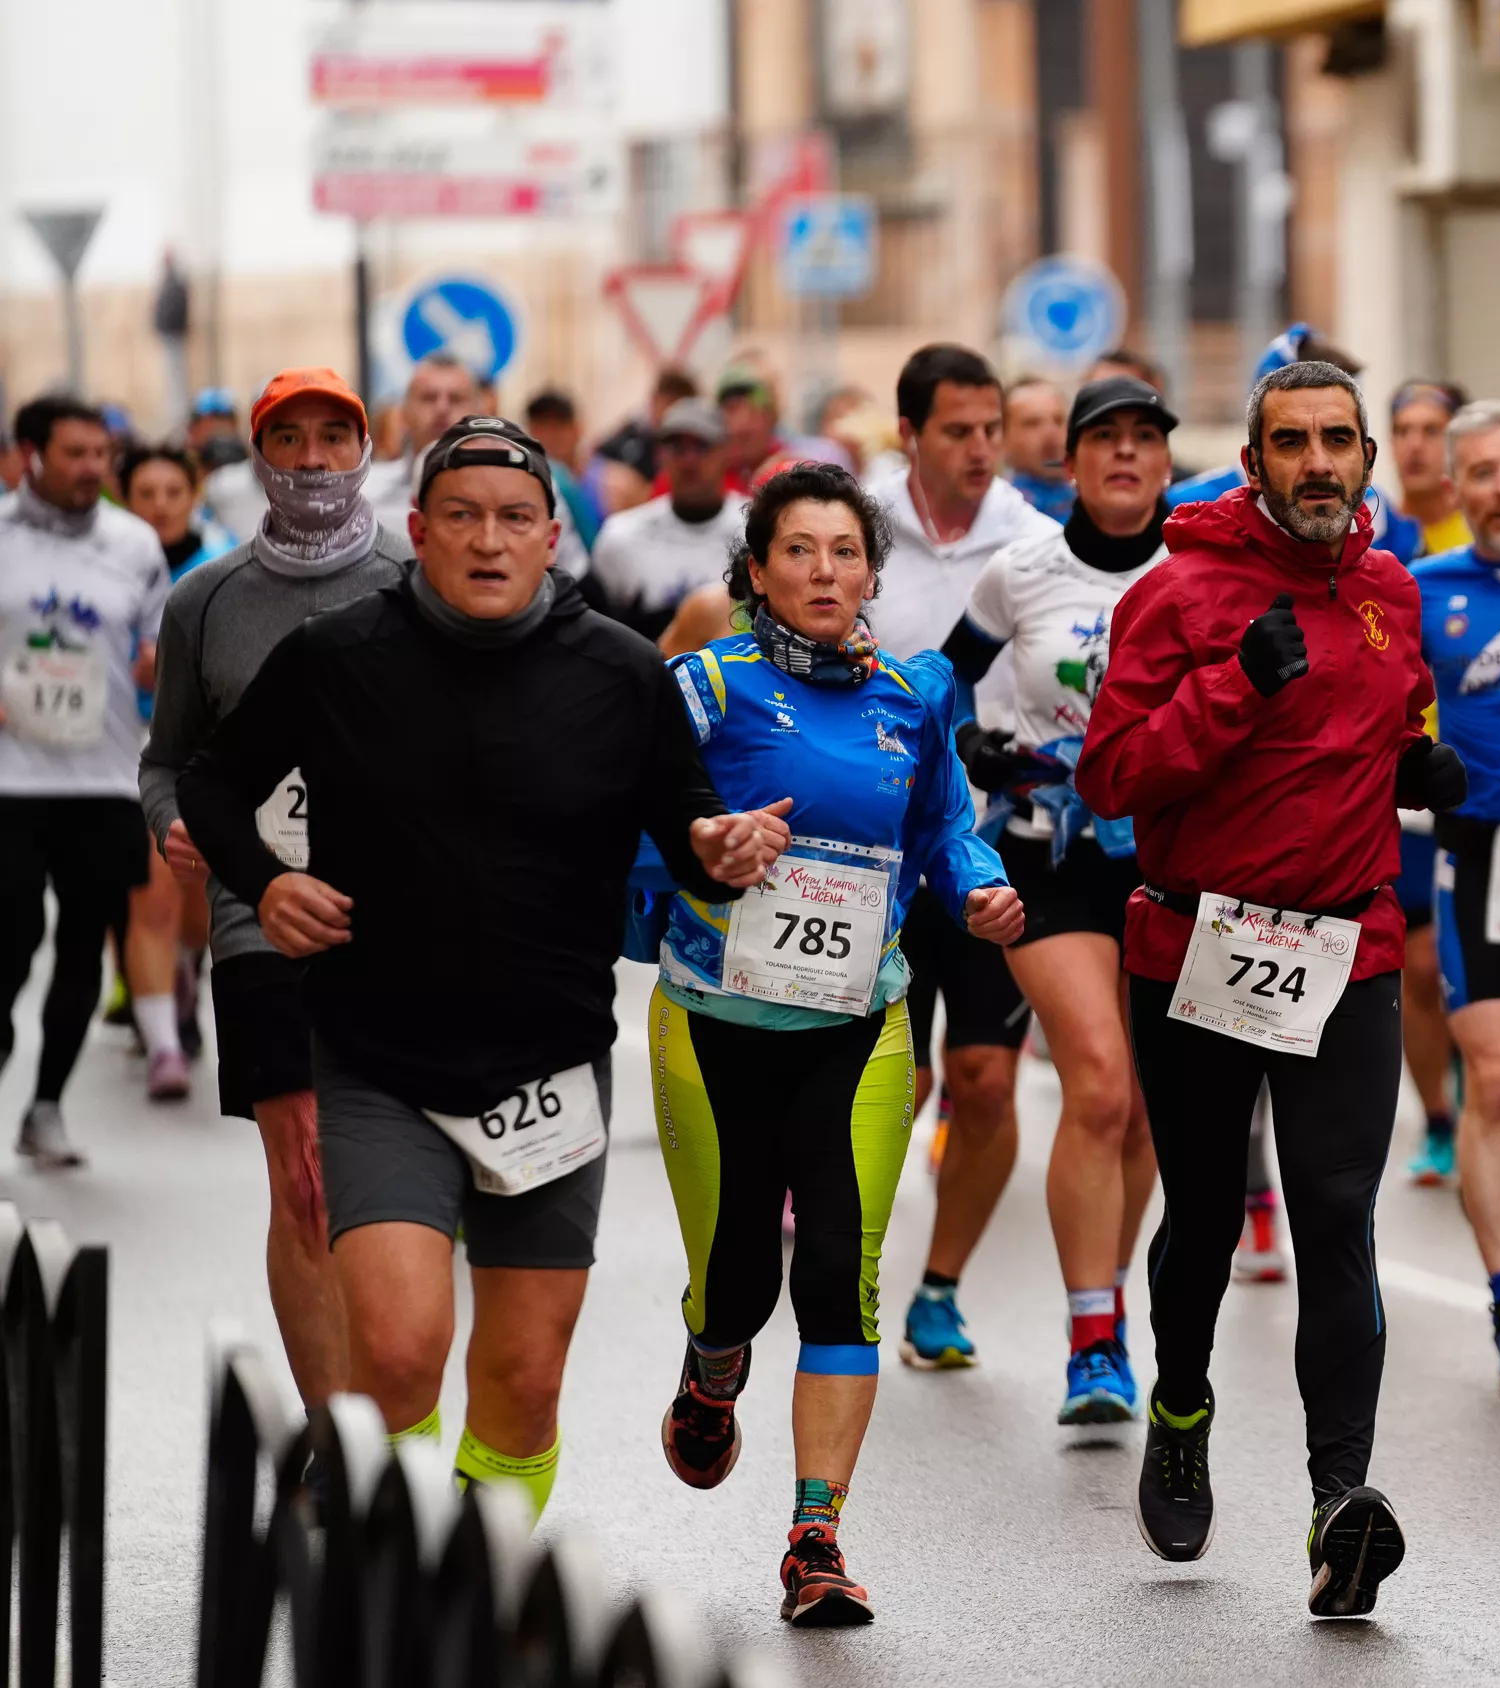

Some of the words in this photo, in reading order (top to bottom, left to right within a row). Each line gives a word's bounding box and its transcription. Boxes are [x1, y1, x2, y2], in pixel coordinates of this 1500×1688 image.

[801, 885, 848, 907] LUCENA
[1144, 885, 1165, 903] alenji
[773, 911, 852, 960] 785
[1257, 929, 1305, 951] LUCENA
[765, 960, 792, 971] YOLANDA
[792, 964, 824, 975] RODRÍGUEZ
[824, 970, 848, 979] ORDUÑA
[1225, 954, 1307, 1003] 724
[1232, 998, 1246, 1008] JOSÉ
[1245, 1003, 1265, 1014] PRETEL
[1264, 1008, 1283, 1018] LÓPEZ
[658, 1007, 670, 1041] C.D.
[657, 1046, 667, 1079] LPP
[477, 1078, 562, 1140] 626
[658, 1084, 679, 1150] SPORTS
[902, 1098, 913, 1128] C.D.
